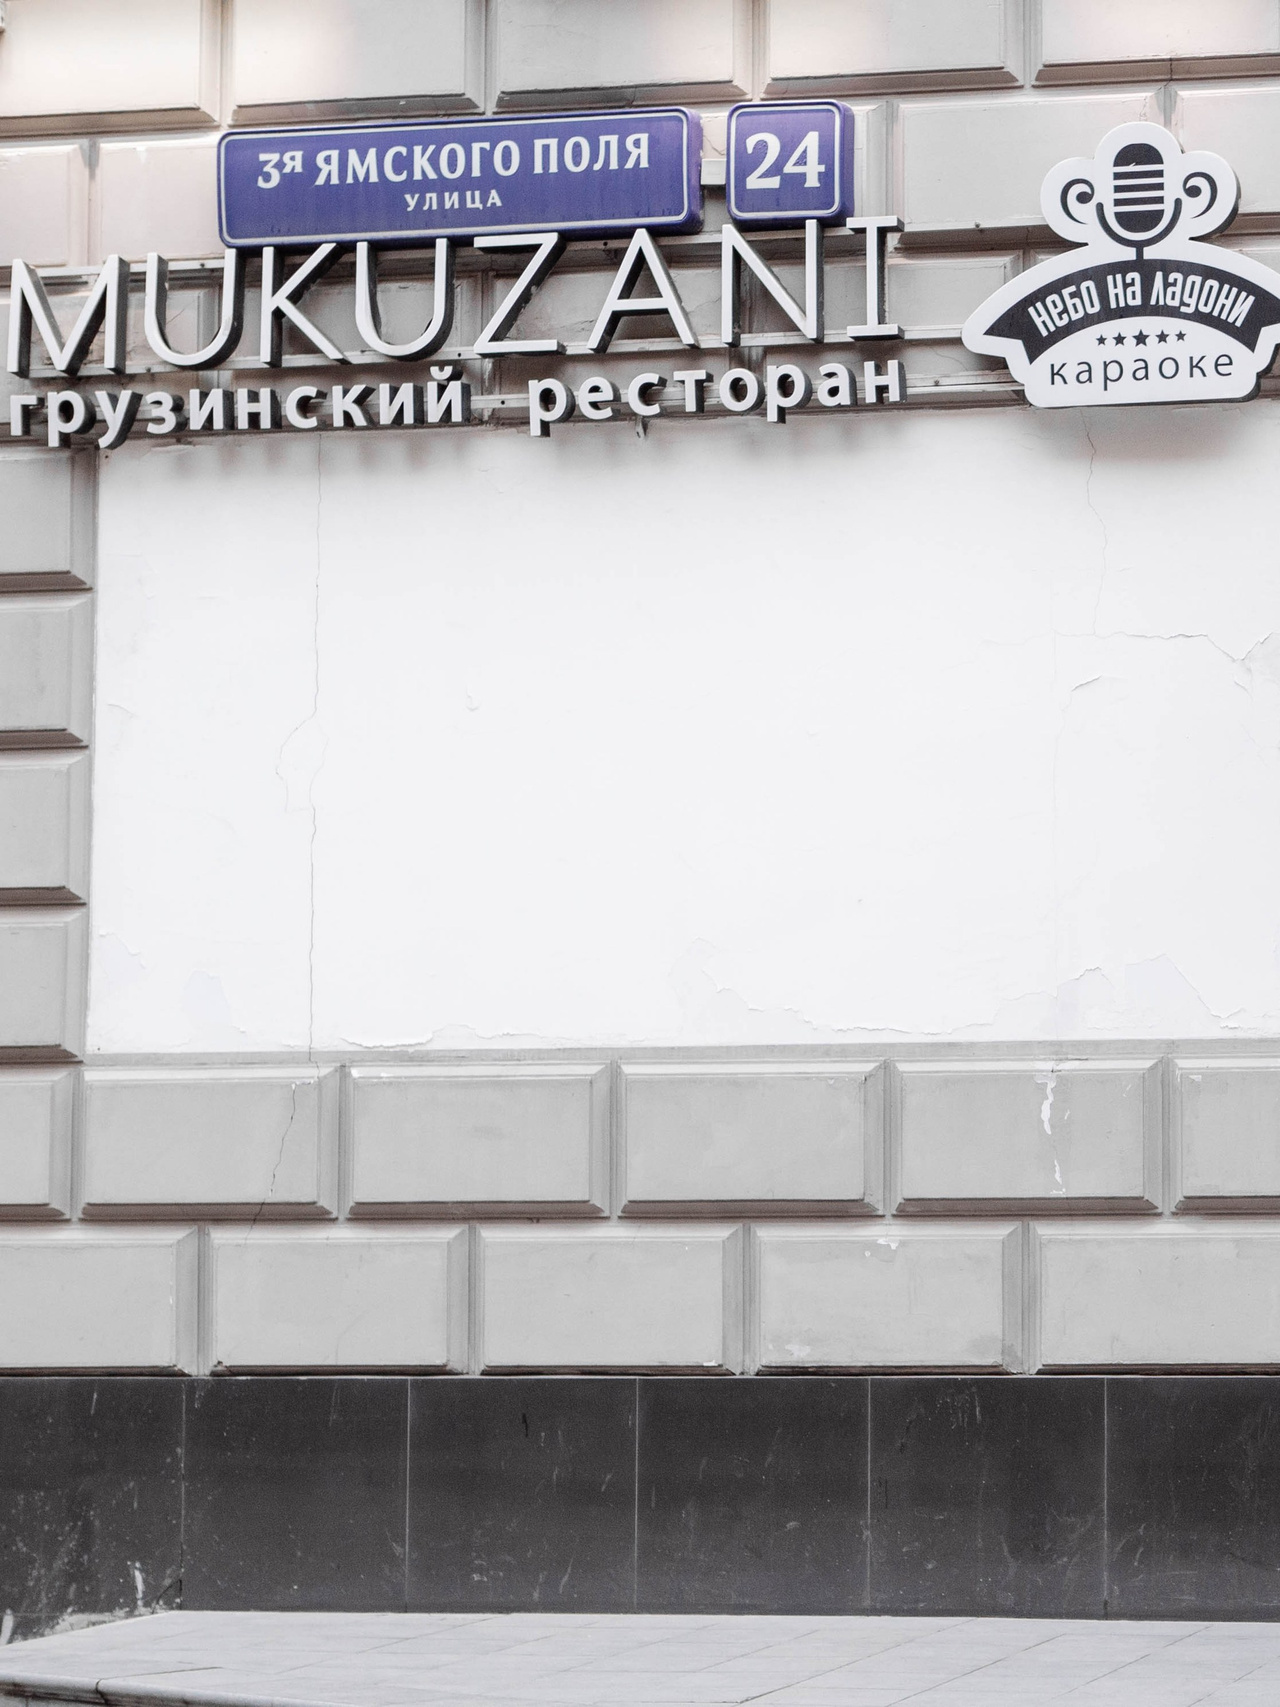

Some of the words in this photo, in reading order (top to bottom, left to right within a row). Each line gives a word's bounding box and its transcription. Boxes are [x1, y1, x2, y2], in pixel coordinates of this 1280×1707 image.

[315, 140, 521, 186] ЯМСКОГО
[533, 133, 650, 175] ПОЛЯ
[745, 131, 826, 190] 24
[404, 189, 503, 212] УЛИЦА
[7, 216, 905, 376] MUKUZANI
[1106, 271, 1143, 310] на
[1049, 353, 1235, 391] караоке
[9, 365, 470, 448] грузинский
[528, 359, 906, 437] ресторан
